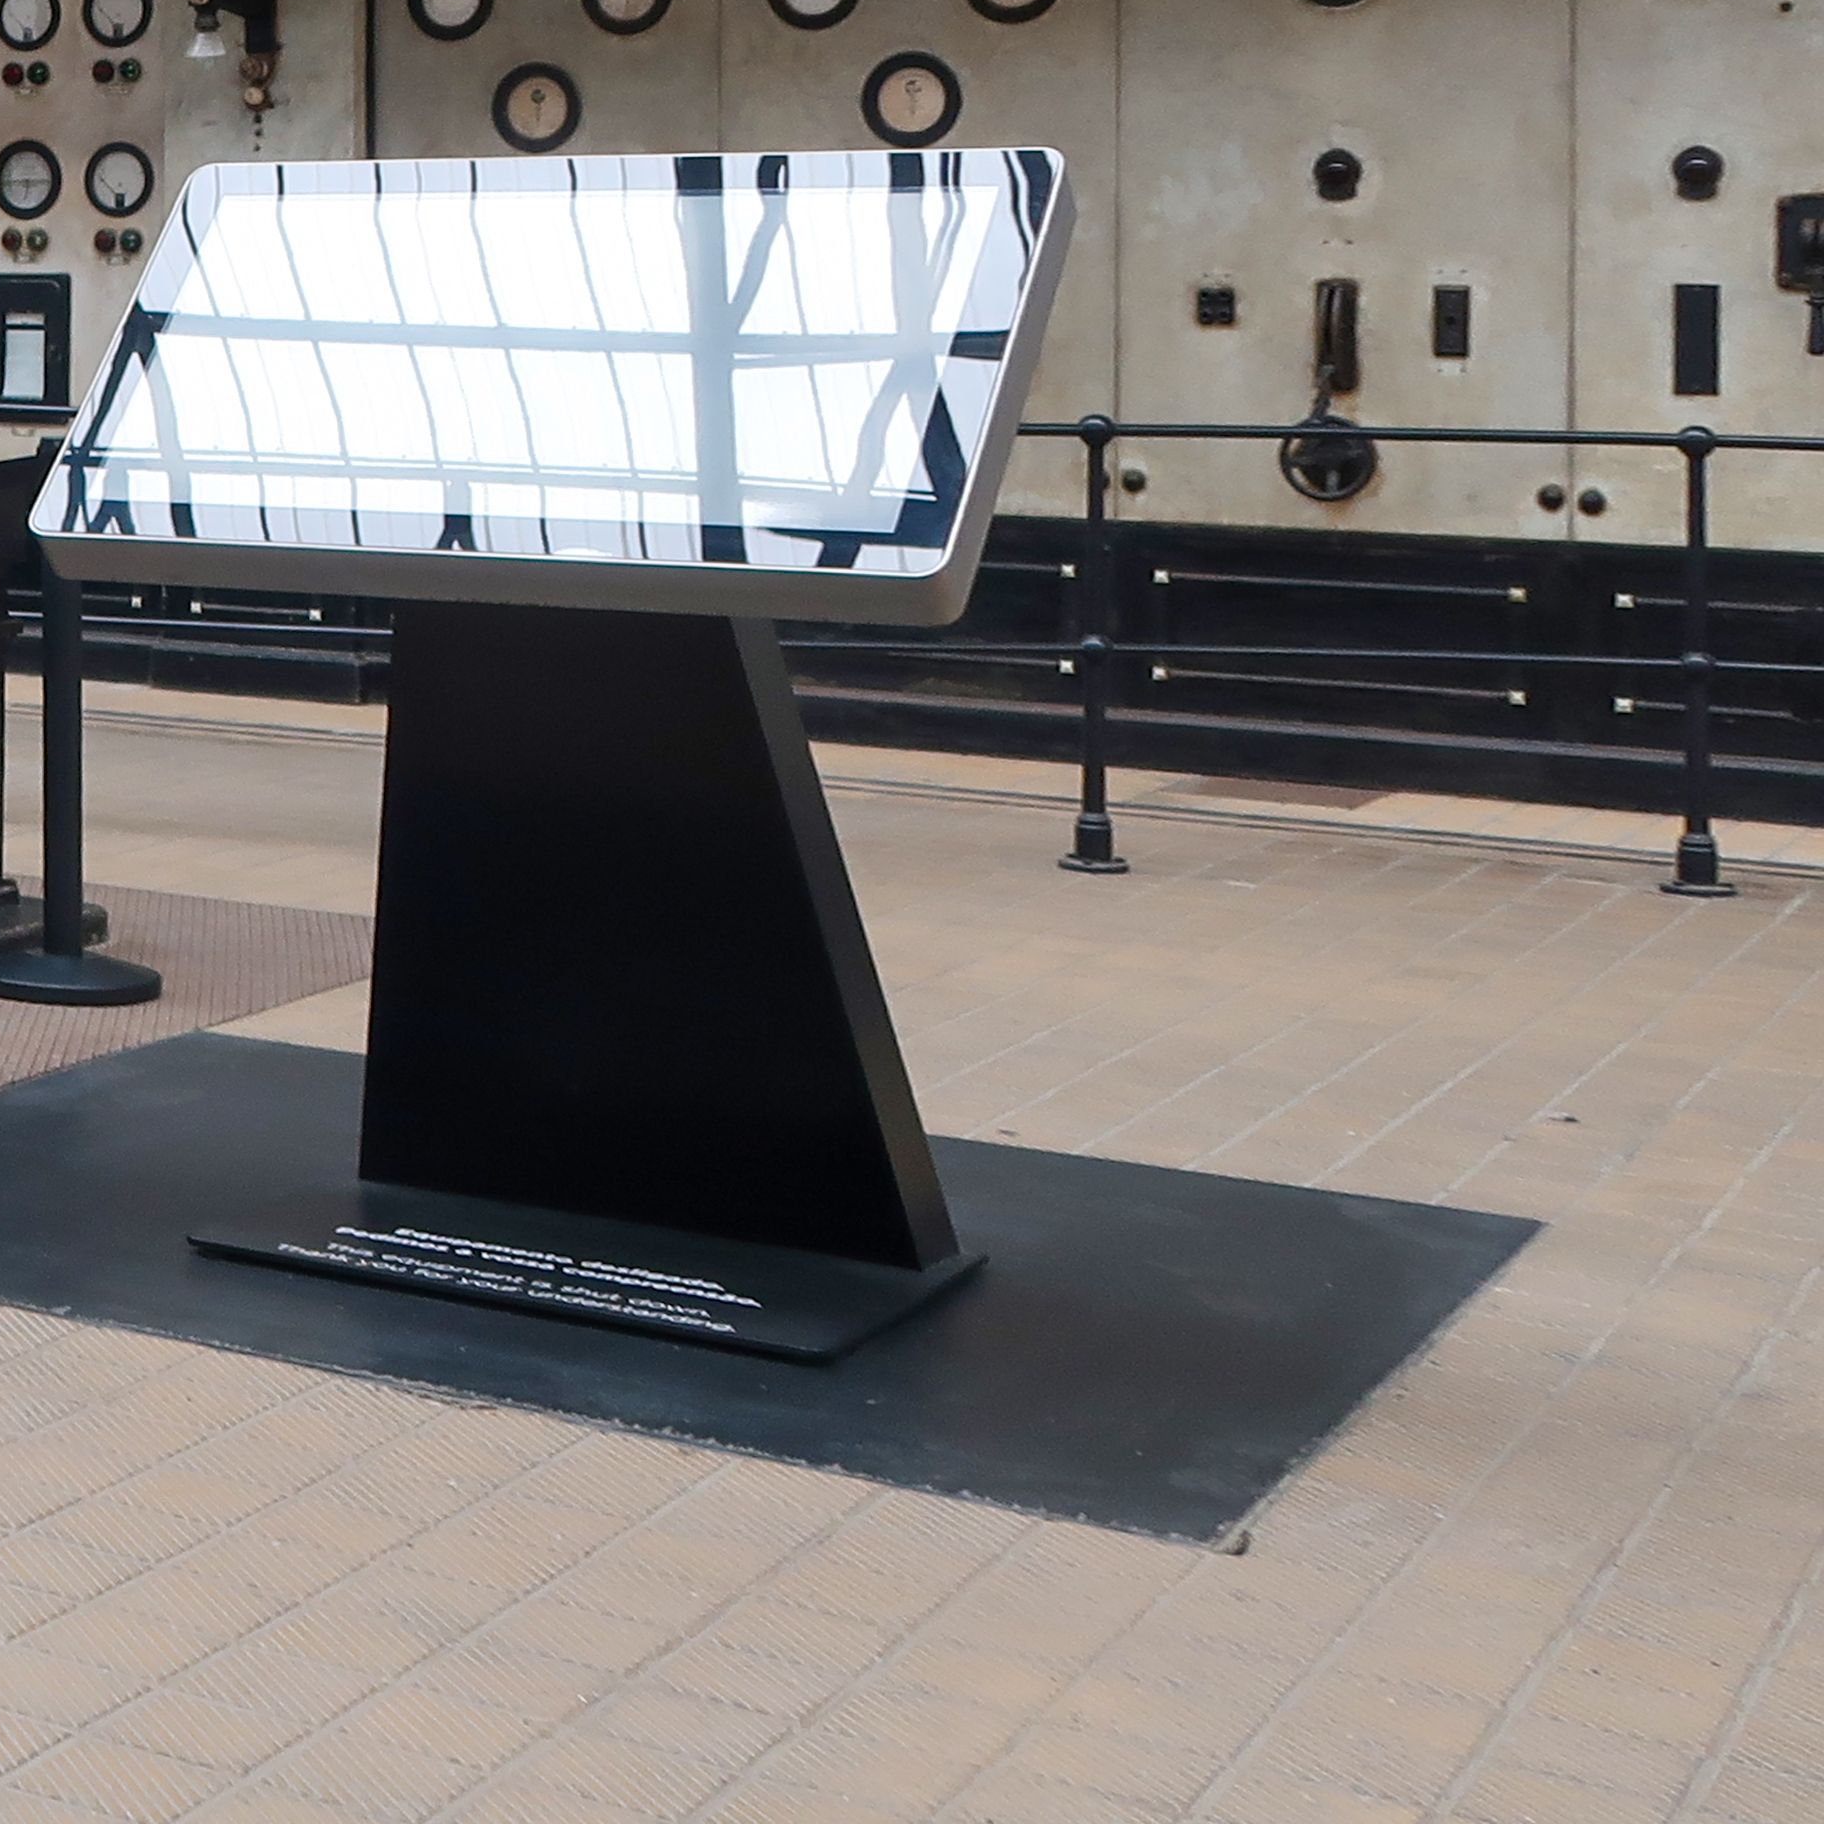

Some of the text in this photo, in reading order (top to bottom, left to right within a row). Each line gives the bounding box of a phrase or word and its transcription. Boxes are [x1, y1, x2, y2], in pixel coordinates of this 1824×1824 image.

[278, 1242, 350, 1264] Thank
[355, 1257, 407, 1273] you
[414, 1267, 453, 1281] for
[457, 1276, 523, 1293] your
[335, 1227, 449, 1253] Pedimos
[455, 1248, 472, 1257] a
[481, 1251, 555, 1271] vossa
[394, 1228, 573, 1264] Equipamento
[328, 1242, 373, 1257] This
[382, 1253, 524, 1283] equipment
[531, 1279, 552, 1290] is
[560, 1285, 621, 1302] shut
